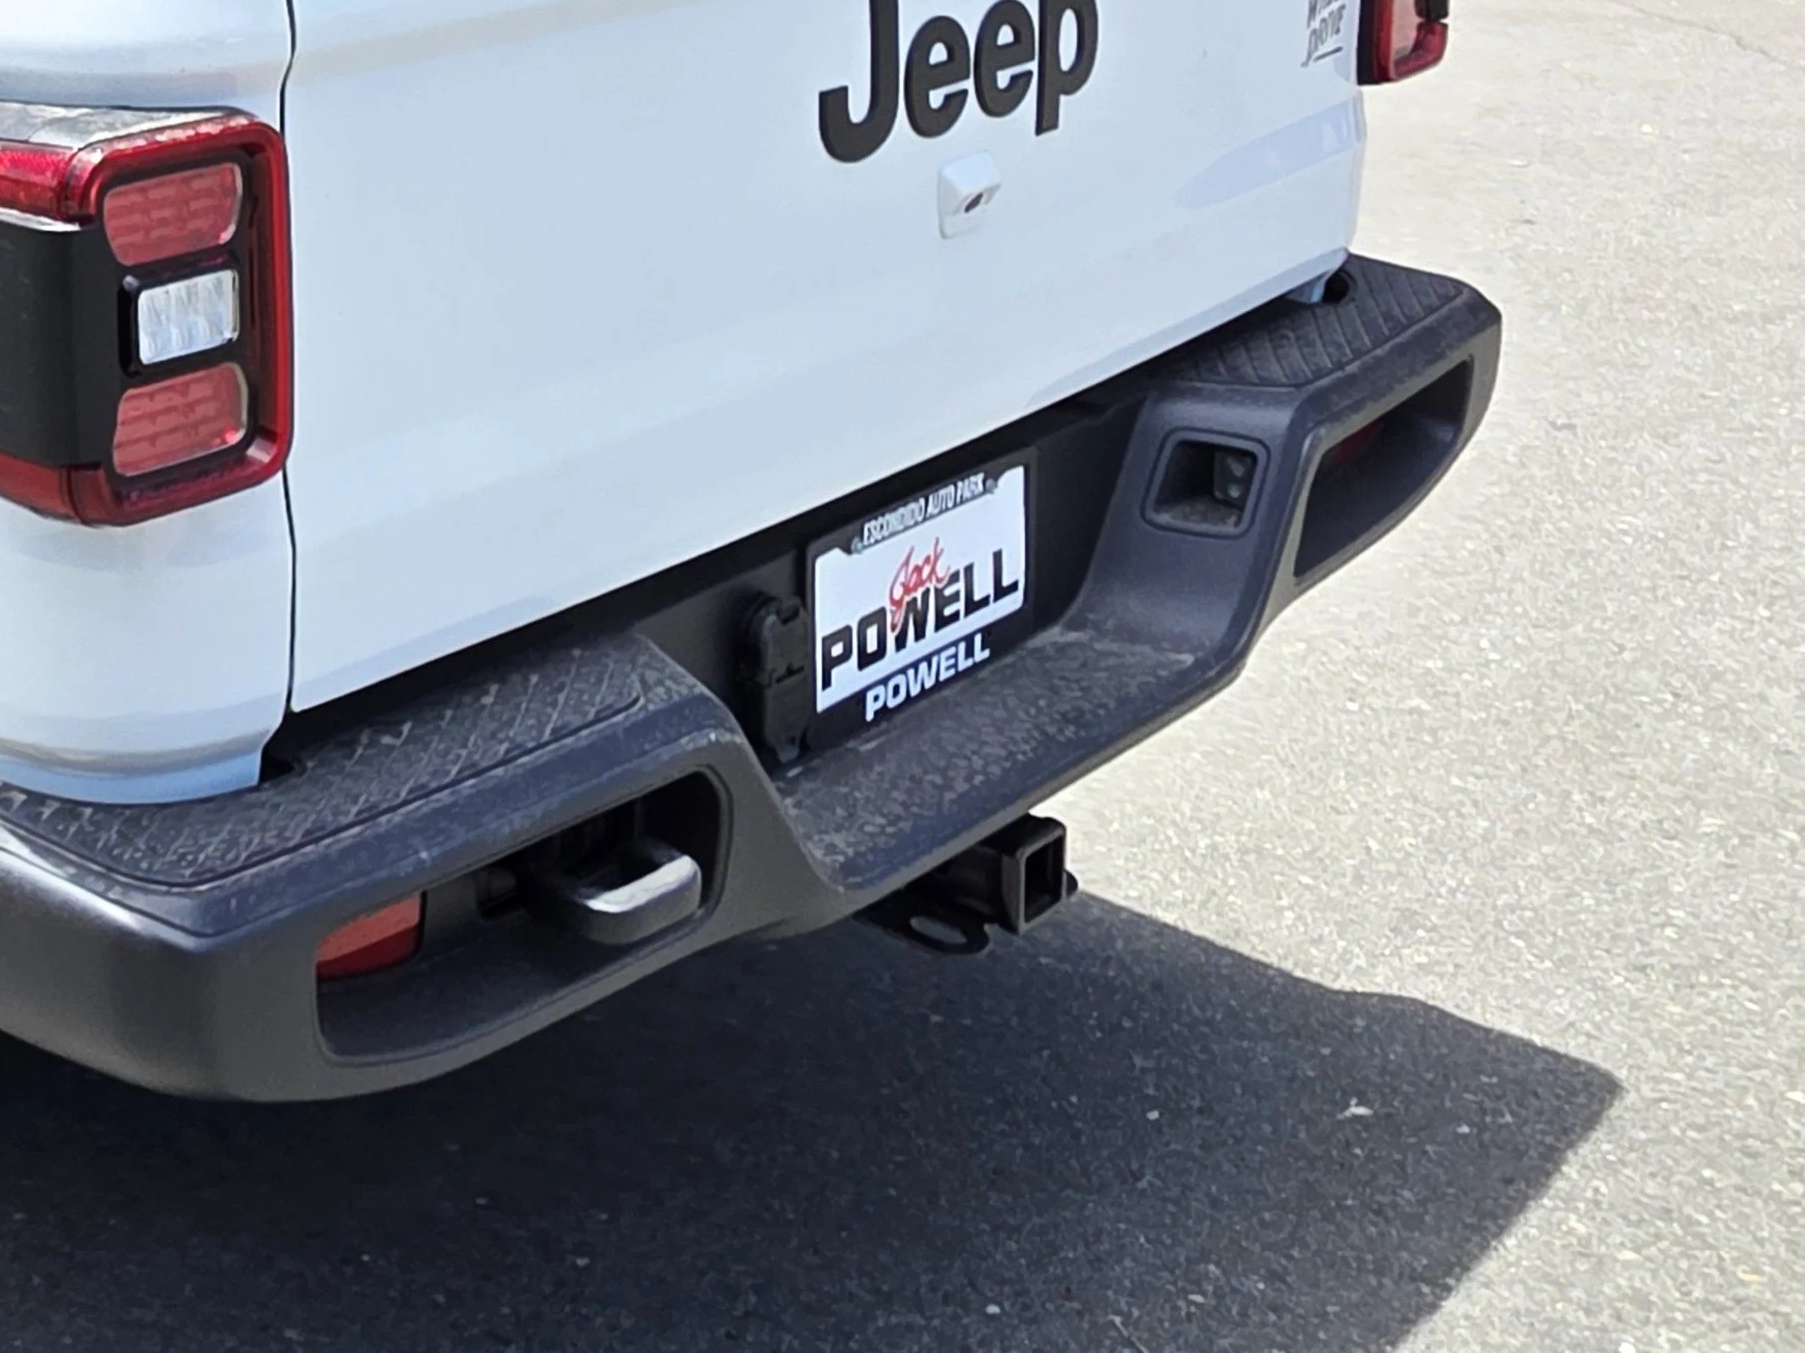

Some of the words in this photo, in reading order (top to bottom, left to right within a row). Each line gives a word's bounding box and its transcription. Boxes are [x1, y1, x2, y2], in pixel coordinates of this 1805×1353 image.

[862, 497, 926, 545] ESCONDIDO
[926, 484, 956, 518] AUTO
[956, 472, 985, 504] PARK
[820, 548, 1020, 693] POWELL
[888, 536, 952, 634] Jack
[864, 634, 991, 722] POWELL
